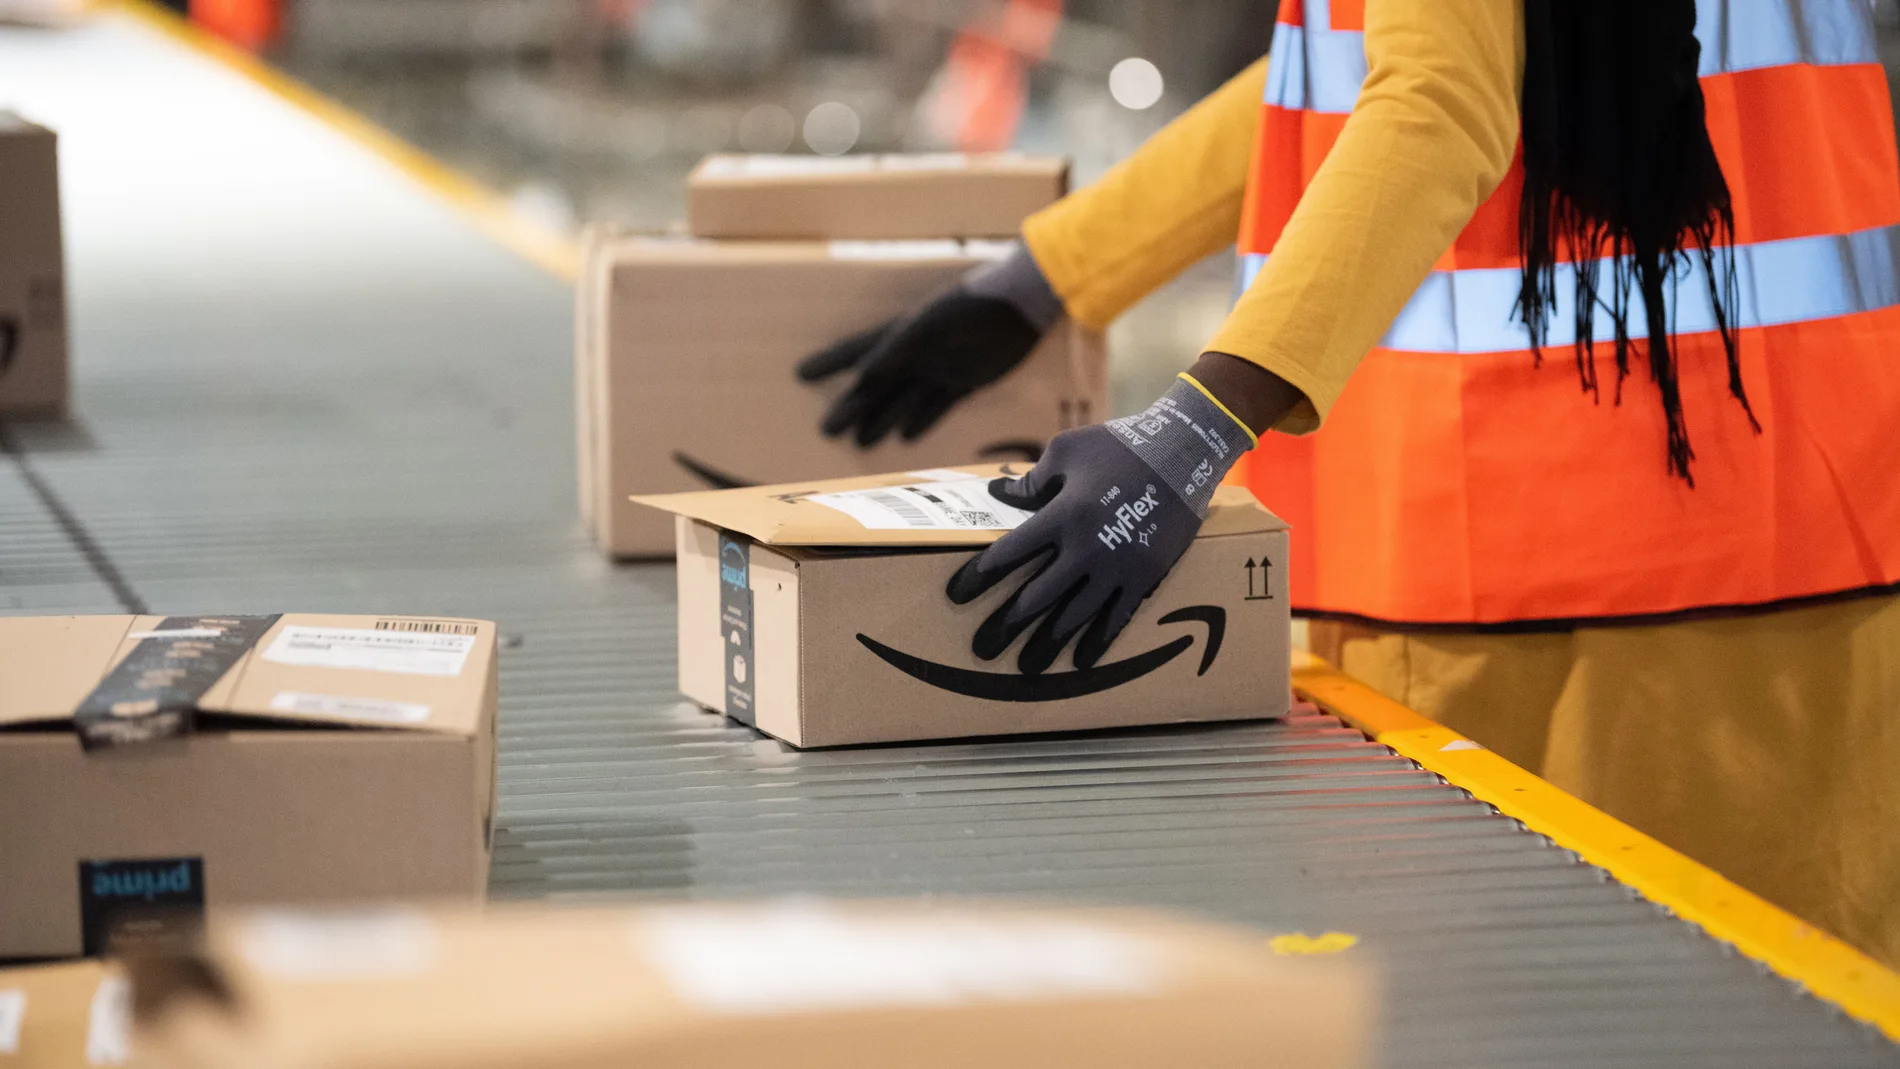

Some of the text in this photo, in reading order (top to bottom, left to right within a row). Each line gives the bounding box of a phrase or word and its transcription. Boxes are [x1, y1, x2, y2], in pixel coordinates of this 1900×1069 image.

[1198, 458, 1213, 477] CE
[1100, 485, 1121, 507] 11-840
[1185, 483, 1195, 496] 8
[721, 563, 748, 592] prime
[91, 861, 190, 901] prime
